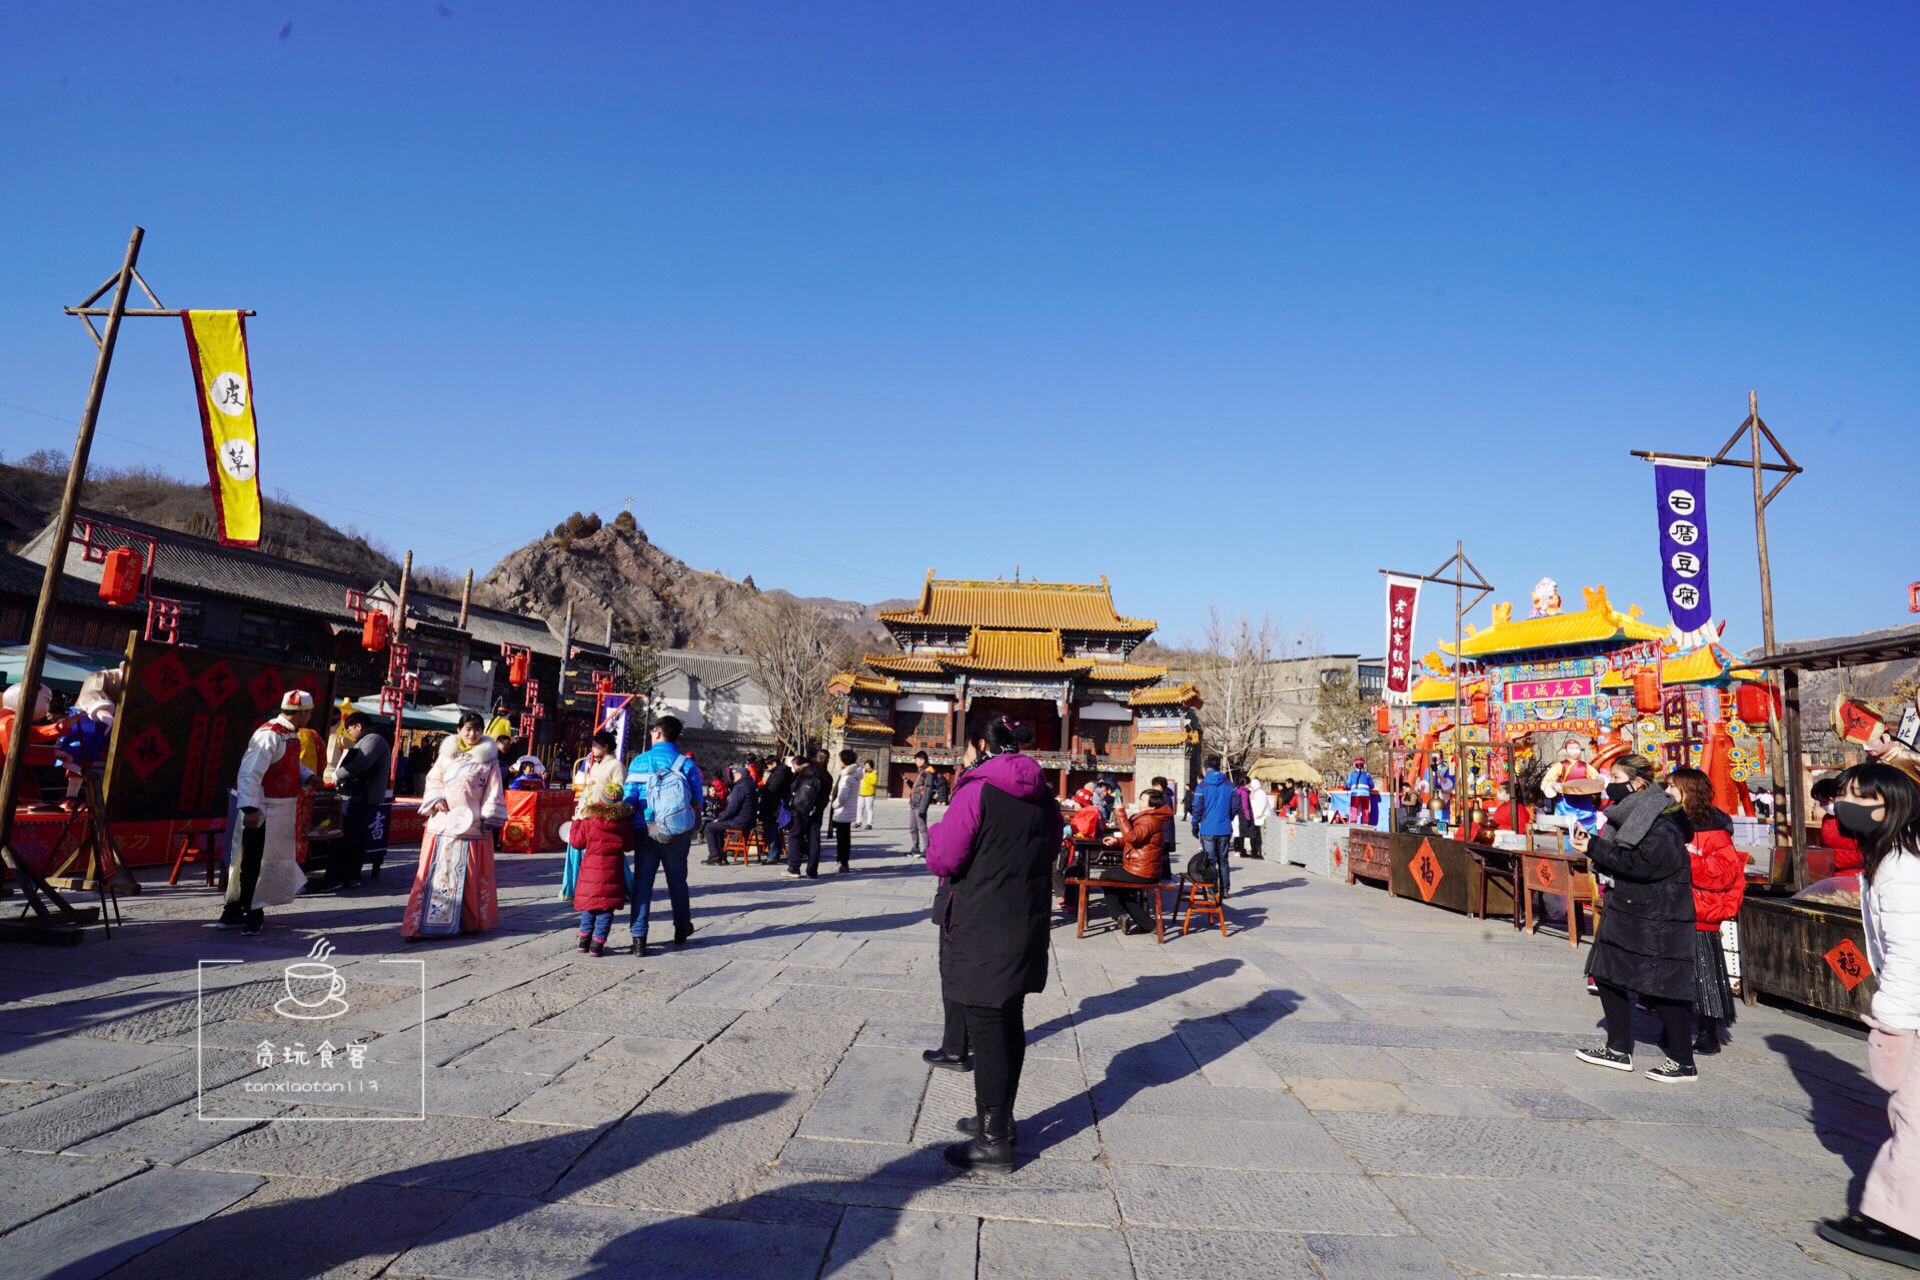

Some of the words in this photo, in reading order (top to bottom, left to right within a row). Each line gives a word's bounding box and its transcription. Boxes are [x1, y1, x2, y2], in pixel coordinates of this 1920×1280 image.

[222, 377, 249, 474] 皮草
[1671, 495, 1699, 606] 石磨豆腐
[1420, 856, 1435, 887] 福
[1836, 950, 1861, 978] 福
